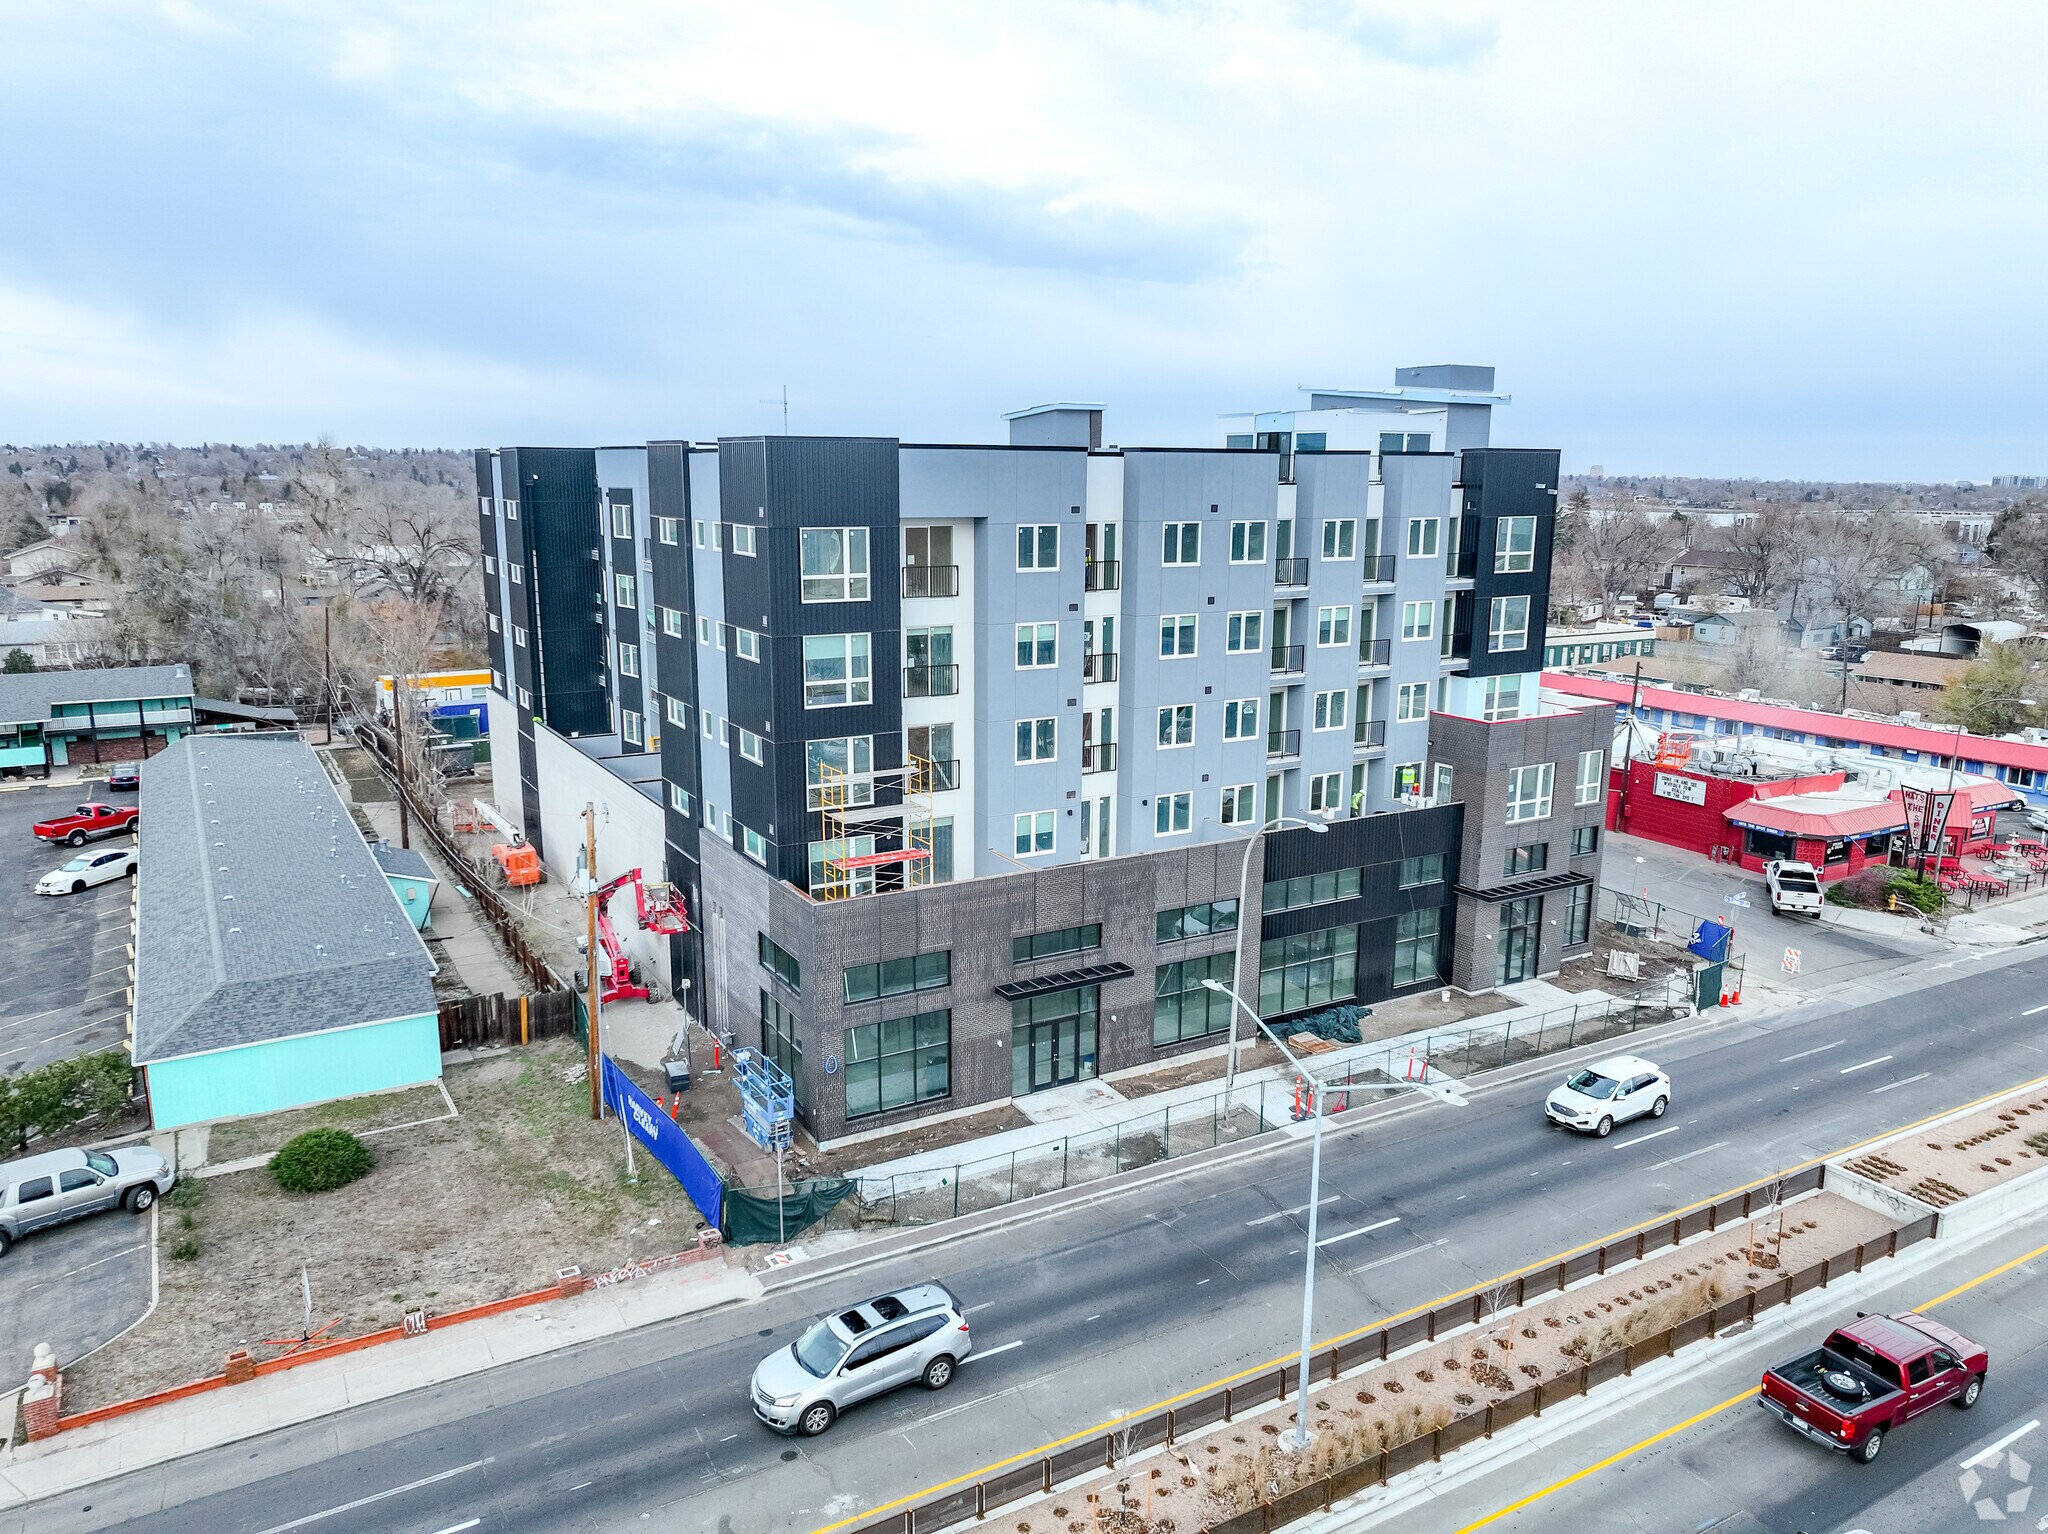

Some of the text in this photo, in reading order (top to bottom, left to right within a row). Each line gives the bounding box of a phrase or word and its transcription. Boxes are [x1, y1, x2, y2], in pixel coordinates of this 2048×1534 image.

[1905, 790, 1925, 802] HITS
[1907, 802, 1924, 814] THE
[1930, 801, 1945, 841] DINER
